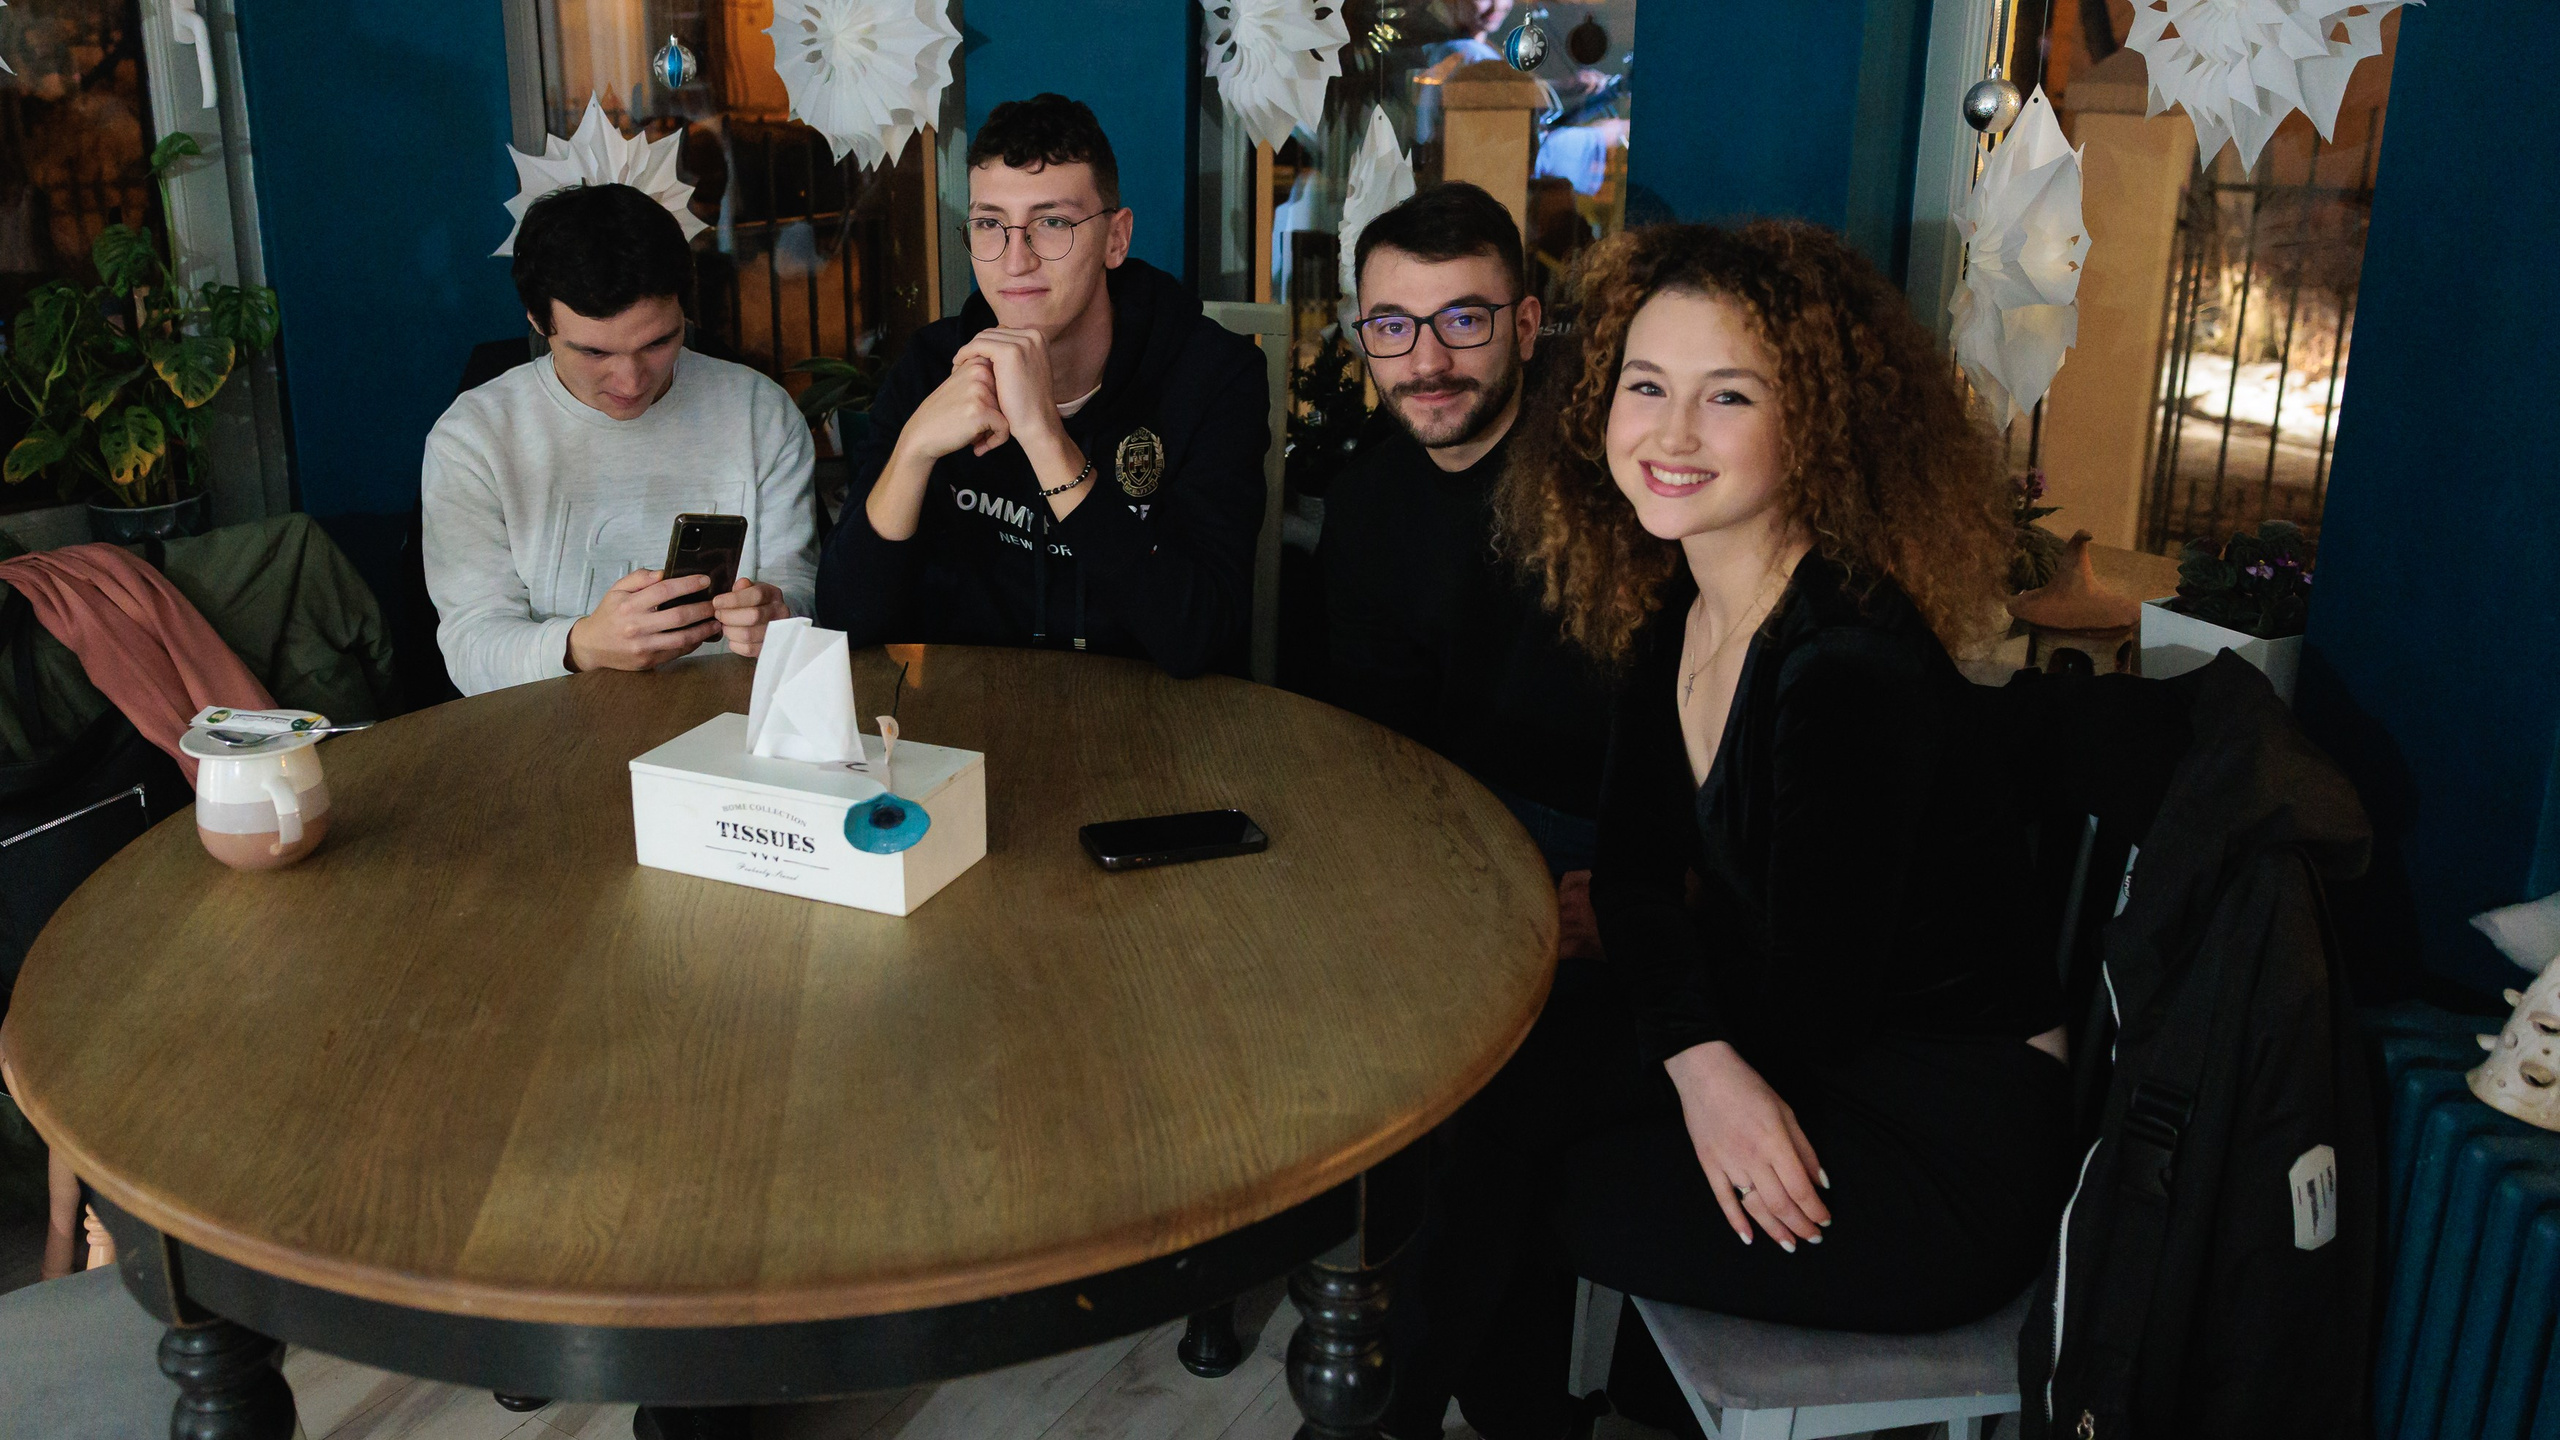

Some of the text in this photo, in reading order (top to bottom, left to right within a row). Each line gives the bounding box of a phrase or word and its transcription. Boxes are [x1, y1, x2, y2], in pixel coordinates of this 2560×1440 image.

[999, 531, 1073, 557] NEW OR
[722, 803, 807, 828] HOME COLLECTION
[716, 820, 816, 854] TISSUES
